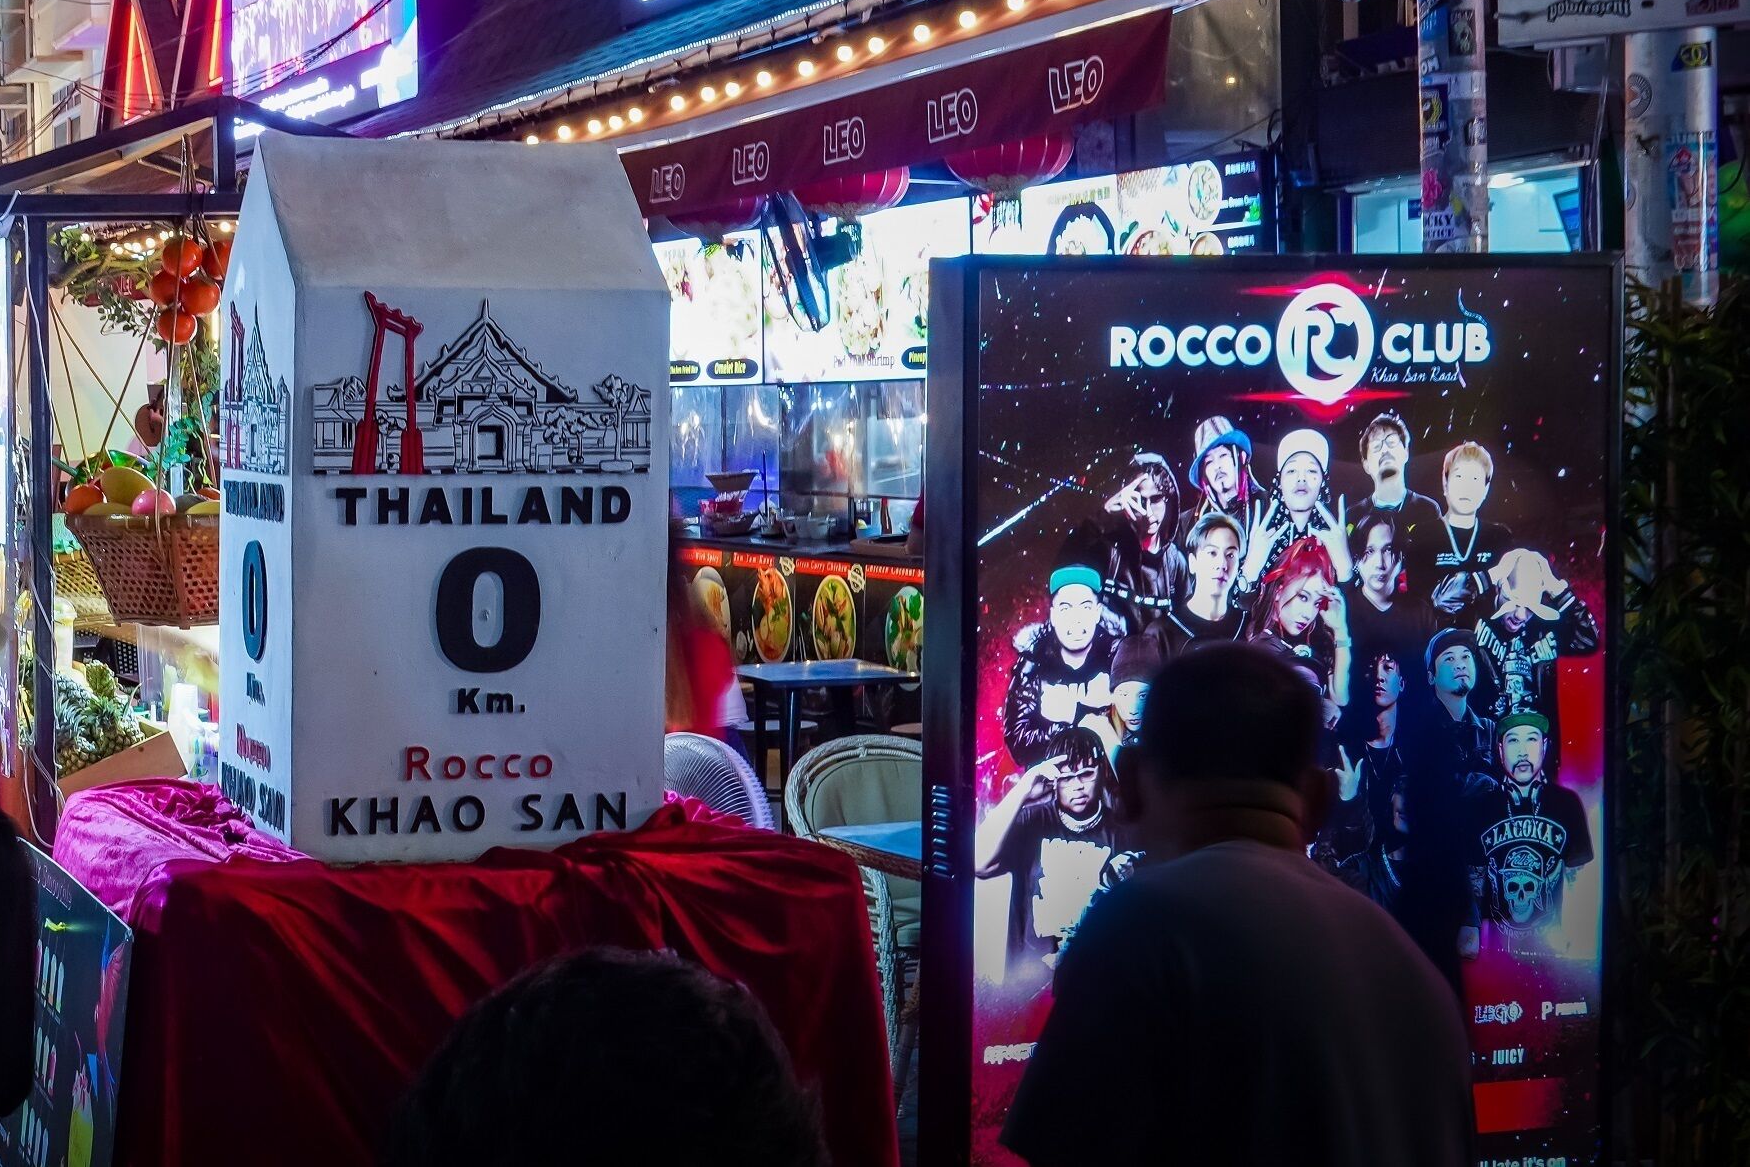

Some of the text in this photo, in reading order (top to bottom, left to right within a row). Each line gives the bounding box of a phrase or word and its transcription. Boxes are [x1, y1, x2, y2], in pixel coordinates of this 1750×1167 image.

[1049, 55, 1104, 114] LEO
[927, 87, 978, 143] LEO
[823, 116, 865, 164] LEO
[651, 163, 686, 203] LEO
[732, 141, 769, 185] LEO
[1110, 325, 1272, 367] ROCCO
[1381, 323, 1491, 364] CLUB
[1429, 365, 1459, 383] Road
[224, 479, 285, 523] THAILAND
[335, 485, 632, 526] THAILAND
[242, 540, 268, 662] 0
[435, 546, 540, 673] 0
[457, 686, 526, 715] Km.
[404, 745, 554, 781] Rocco
[221, 761, 285, 836] KHAO SAN
[326, 790, 628, 837] KHAO SAN
[1492, 1048, 1524, 1065] JUICY
